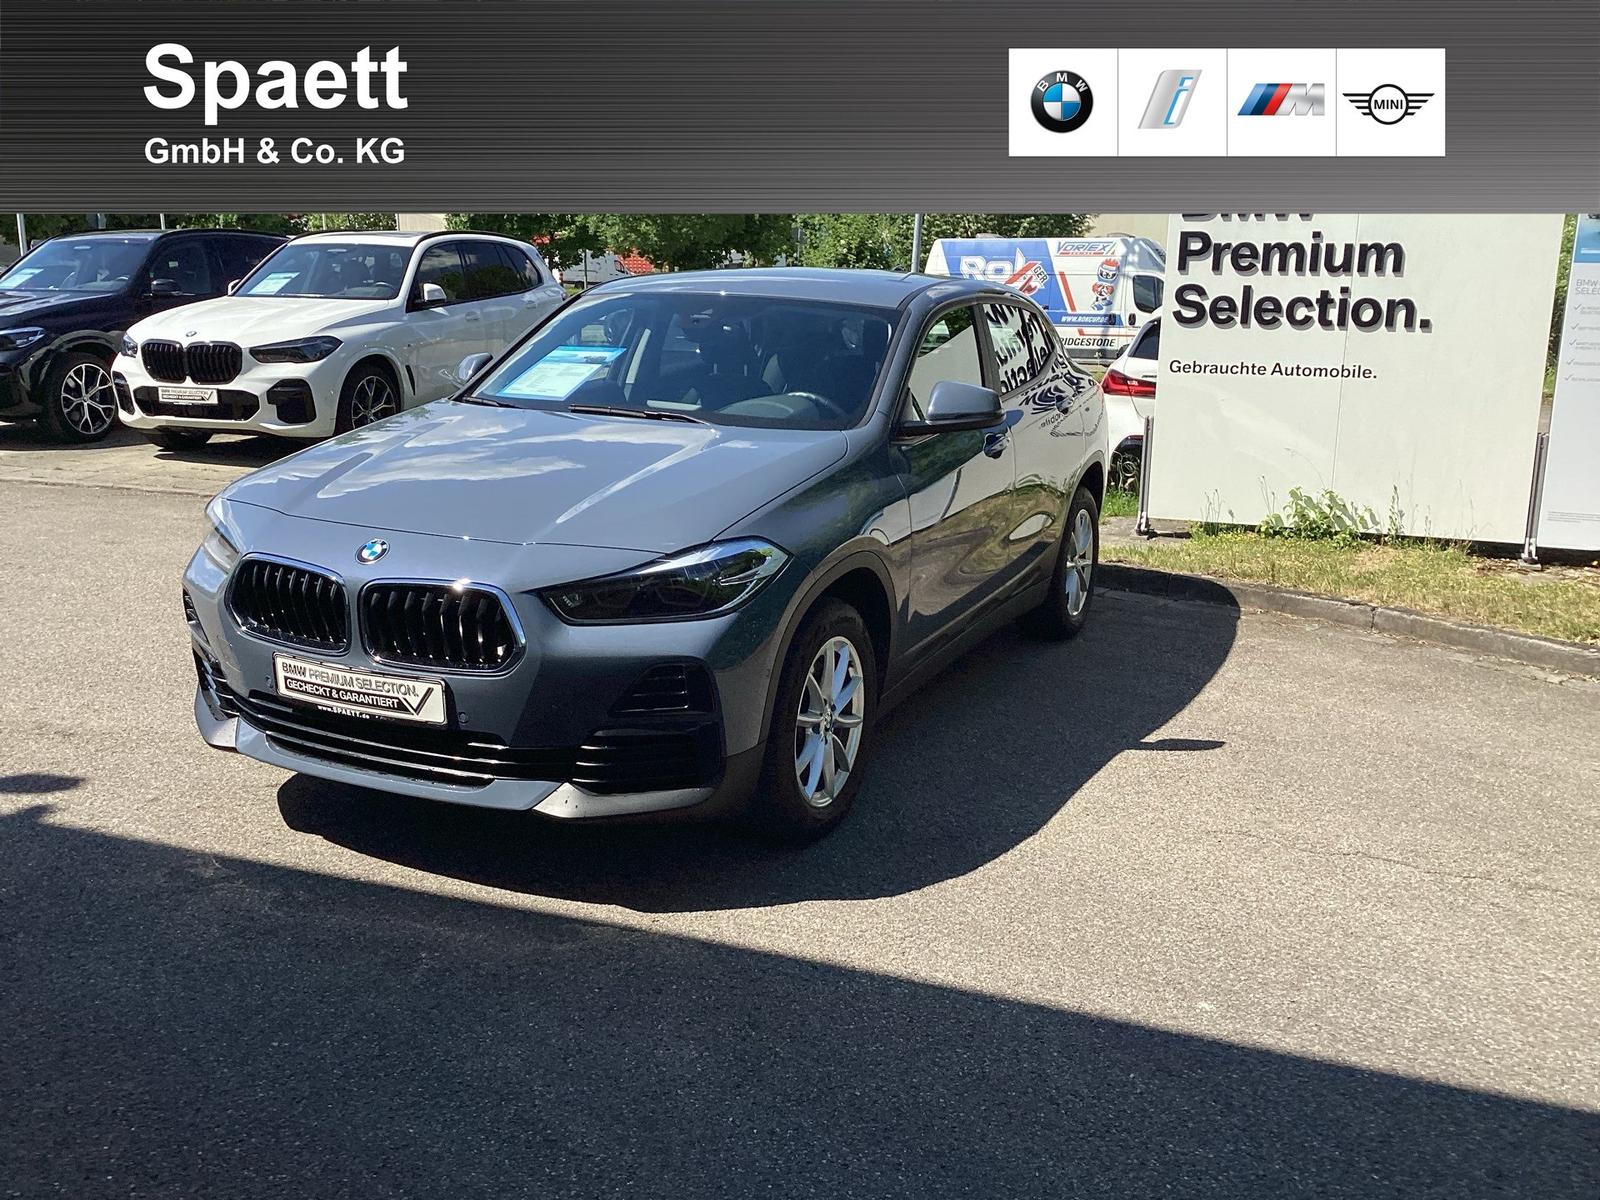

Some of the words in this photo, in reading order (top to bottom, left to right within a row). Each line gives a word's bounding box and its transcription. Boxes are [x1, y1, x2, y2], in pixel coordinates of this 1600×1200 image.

[1057, 241, 1111, 254] VORTEX
[1177, 230, 1406, 277] Premium
[1033, 265, 1048, 283] GER
[1172, 284, 1433, 333] Selection.
[1060, 337, 1116, 347] RIDGESTONE
[1169, 359, 1267, 376] Gebrauchte
[1271, 362, 1378, 380] Automobile.
[282, 662, 307, 678] BMW
[308, 667, 355, 688] PREMIUM
[355, 677, 419, 697] SELECTION.
[286, 679, 331, 697] GECHECKT
[331, 689, 339, 699] &
[339, 690, 399, 708] GARANTIERT
